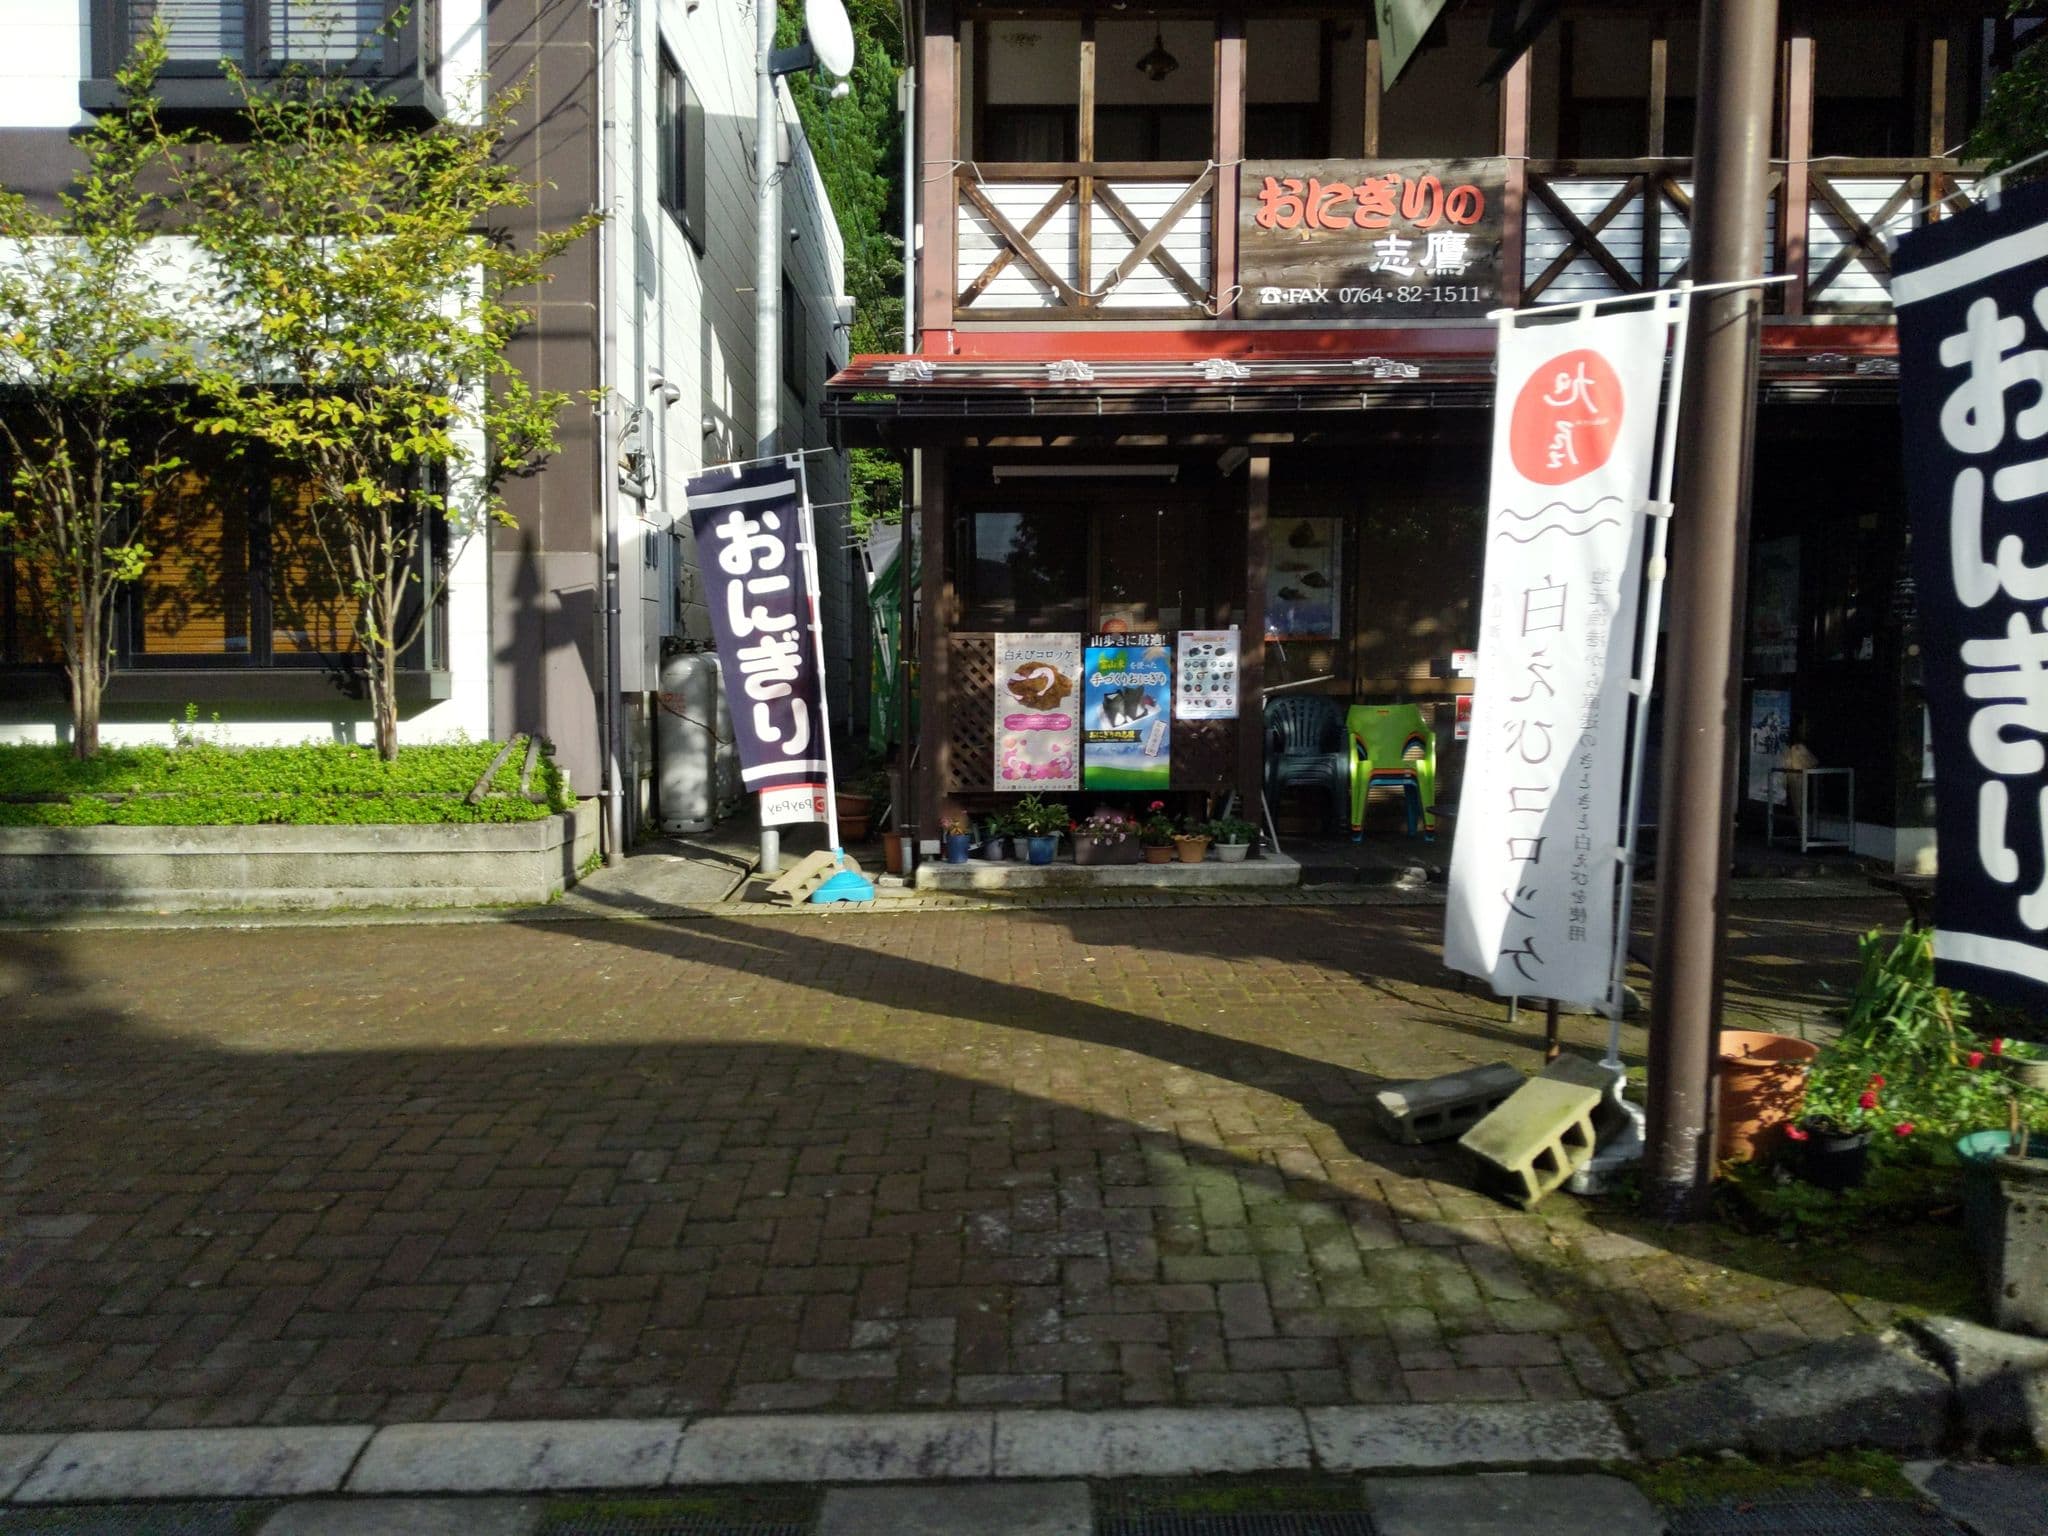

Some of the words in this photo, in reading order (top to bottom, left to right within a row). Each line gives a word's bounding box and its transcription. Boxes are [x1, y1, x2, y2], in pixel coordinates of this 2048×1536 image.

[1255, 173, 1485, 229] おにぎりの
[1369, 231, 1471, 276] 志鷹
[715, 511, 811, 756] おにぎり
[1005, 650, 1073, 661] 白えびコロッケ
